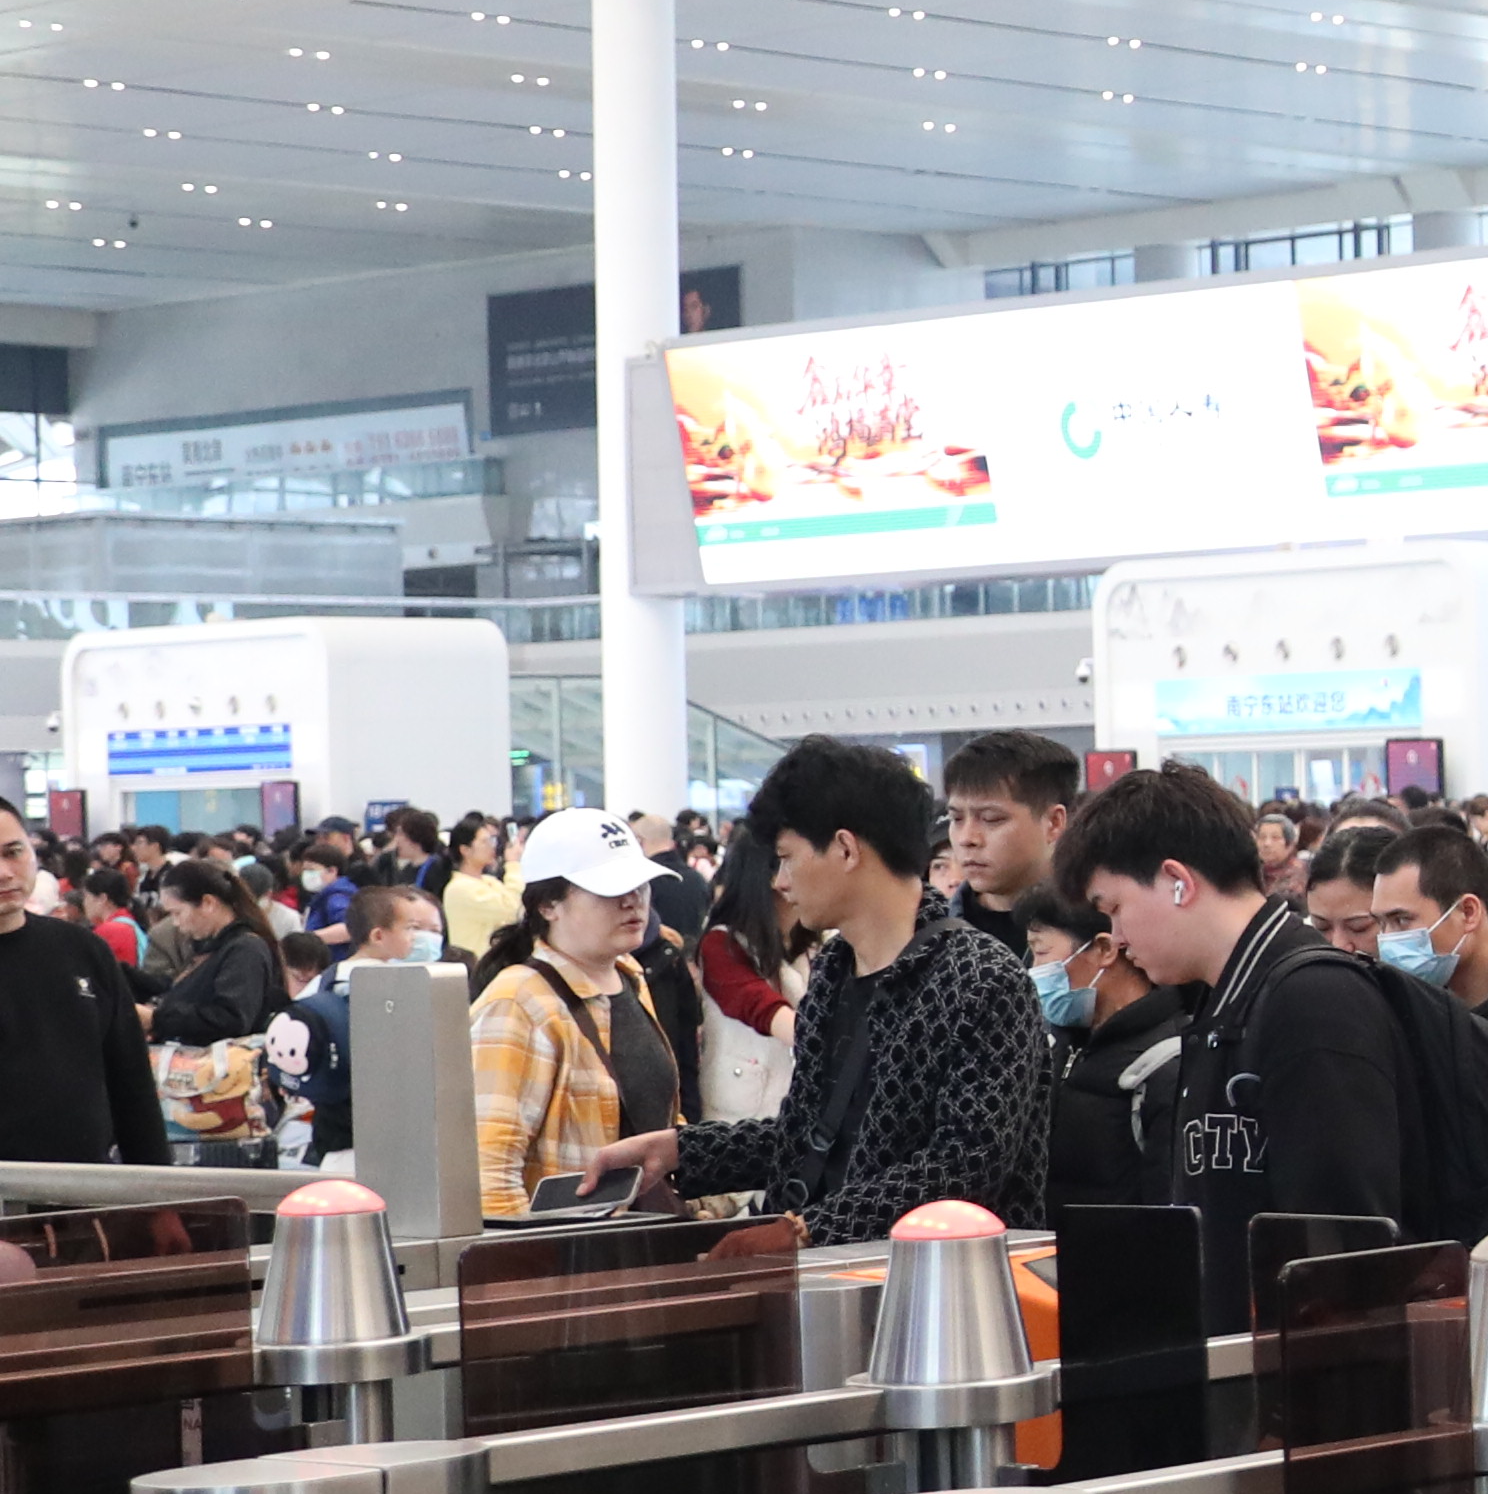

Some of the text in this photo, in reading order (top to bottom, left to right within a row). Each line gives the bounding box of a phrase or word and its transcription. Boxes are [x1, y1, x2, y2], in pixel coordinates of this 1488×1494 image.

[1226, 690, 1346, 717] 南宁东站欢迎您
